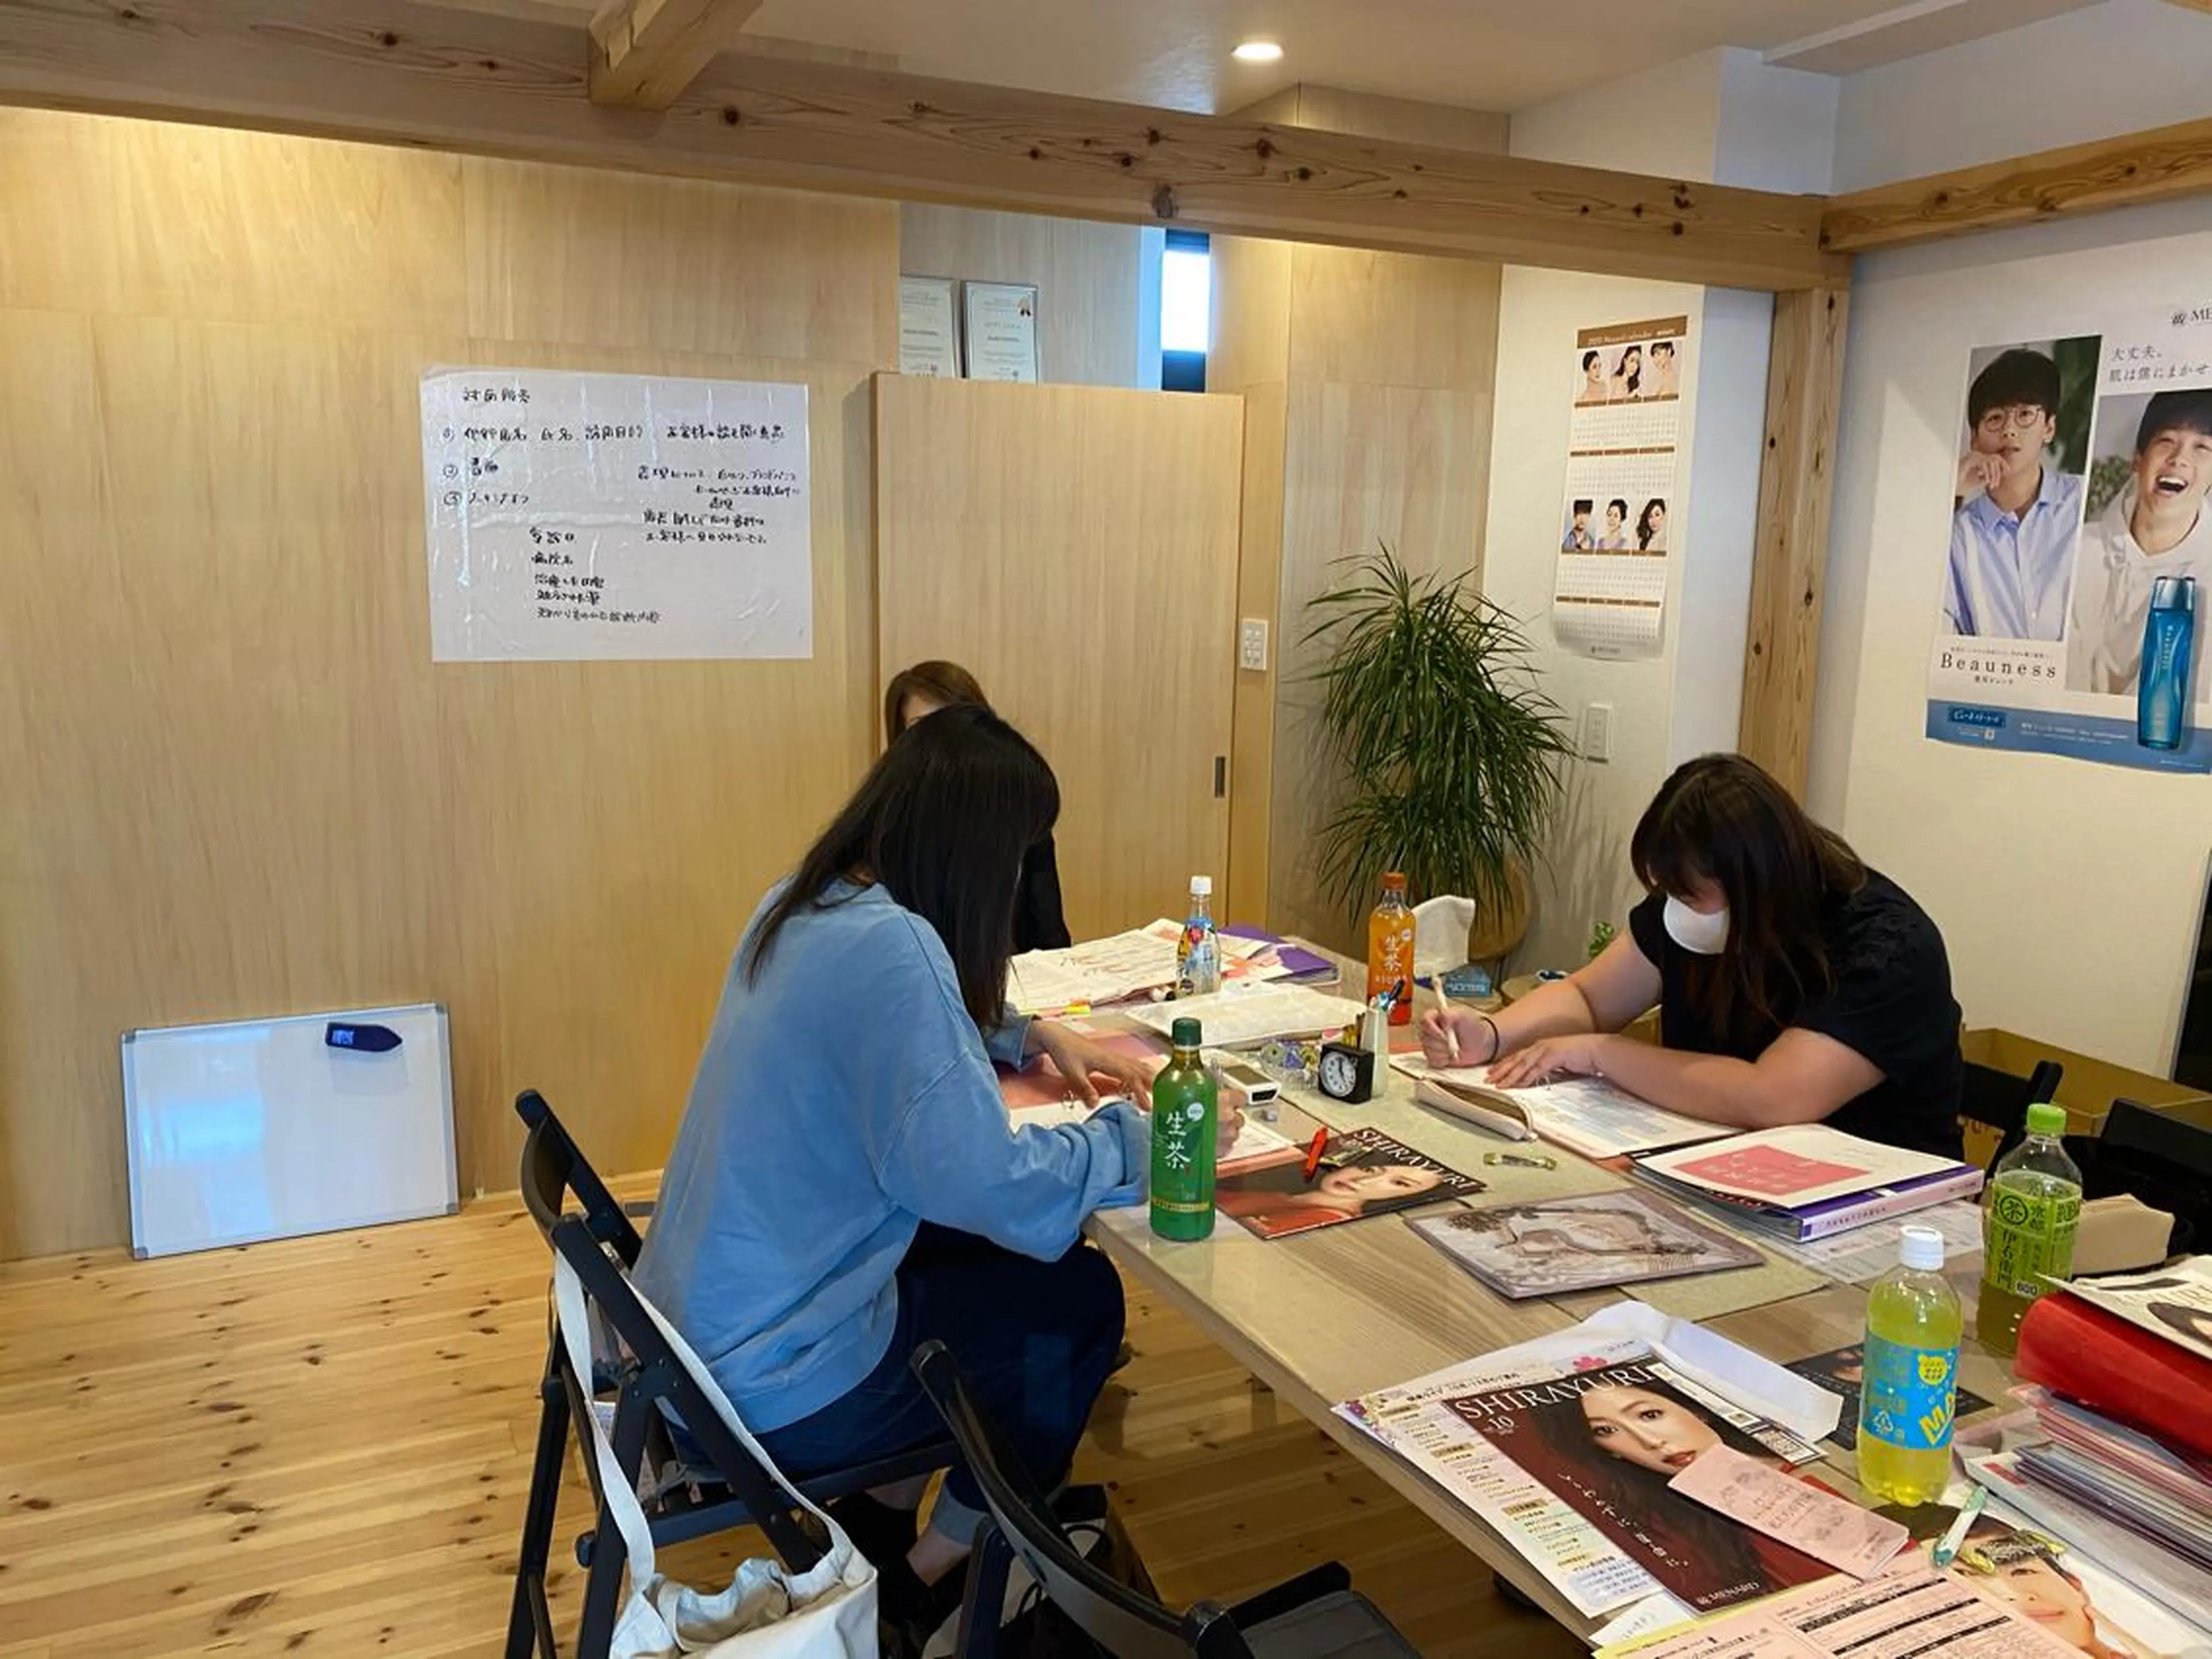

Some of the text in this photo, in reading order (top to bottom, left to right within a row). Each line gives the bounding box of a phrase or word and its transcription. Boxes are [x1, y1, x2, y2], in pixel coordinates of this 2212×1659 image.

[1941, 653, 2057, 679] Beauness
[1164, 1111, 1192, 1170] 生茶
[1353, 1129, 1478, 1189] SHIRAYURI
[1455, 1365, 1654, 1419] SHIRAYURI
[1487, 1415, 1514, 1430] 10
